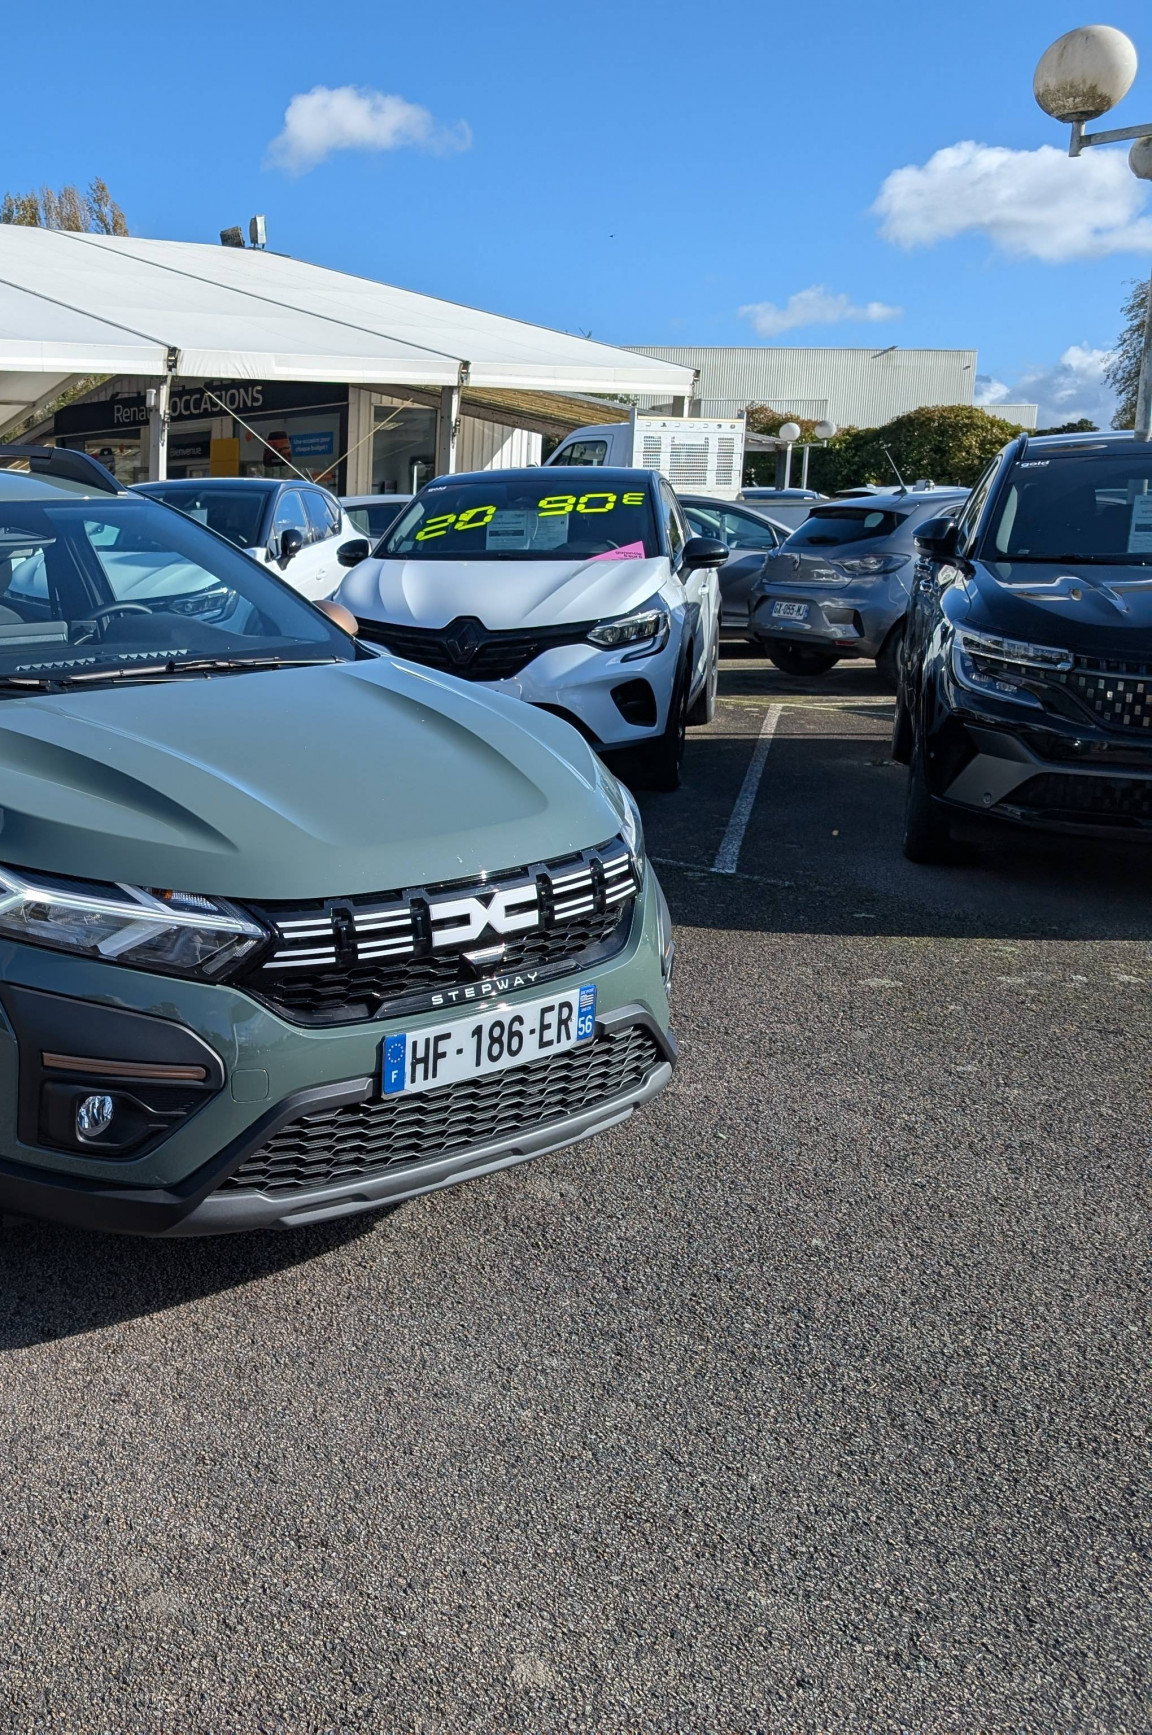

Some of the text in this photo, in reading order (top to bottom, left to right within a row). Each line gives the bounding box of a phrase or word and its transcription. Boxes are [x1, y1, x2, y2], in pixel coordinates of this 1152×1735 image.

[169, 385, 264, 418] OCCASIONS
[415, 505, 497, 541] 20
[431, 971, 539, 1006] STEPWAY
[391, 1000, 593, 1085] F HF-186-ER 56
